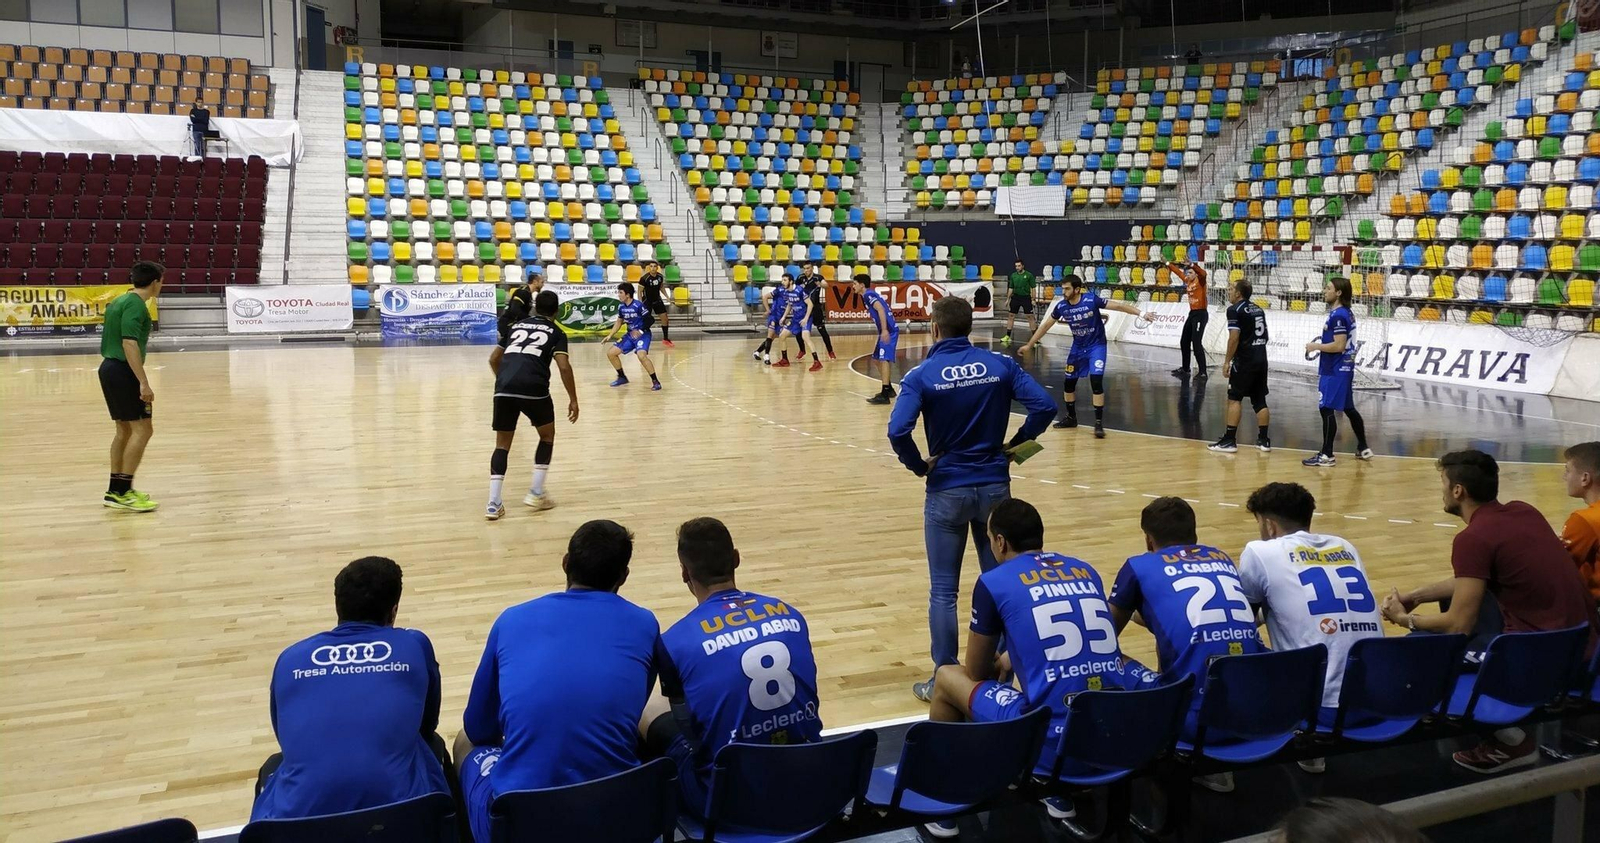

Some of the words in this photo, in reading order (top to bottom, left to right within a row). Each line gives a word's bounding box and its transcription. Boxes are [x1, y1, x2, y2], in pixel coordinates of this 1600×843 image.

[266, 299, 313, 308] TOYOTA
[410, 289, 454, 299] Sánchez
[457, 289, 494, 299] Palacio
[832, 285, 925, 309] VIELA
[31, 303, 111, 318] AMARILL
[905, 309, 923, 318] Real
[1155, 314, 1185, 323] TOYOTA
[1254, 316, 1265, 337] 5
[504, 329, 549, 357] 22
[1305, 334, 1531, 385] CLATRAVA
[934, 382, 955, 391] Tresa
[956, 375, 1000, 388] Automoción
[1019, 567, 1092, 586] UCLM
[1164, 565, 1182, 577] O.
[1029, 581, 1099, 602] PINILLA
[1298, 566, 1376, 616] 13
[1172, 575, 1256, 629] 25
[700, 602, 790, 634] UCLM
[1339, 619, 1378, 632] irema
[702, 627, 759, 656] DAVID
[761, 618, 801, 637] ABAD
[1031, 597, 1118, 662] 55
[1203, 628, 1255, 643] Leclerc
[293, 667, 327, 680] Tresa
[331, 661, 410, 675] Automoción
[741, 640, 796, 711] 8
[1059, 660, 1116, 679] Leclerc
[741, 711, 805, 739] Leclerc
